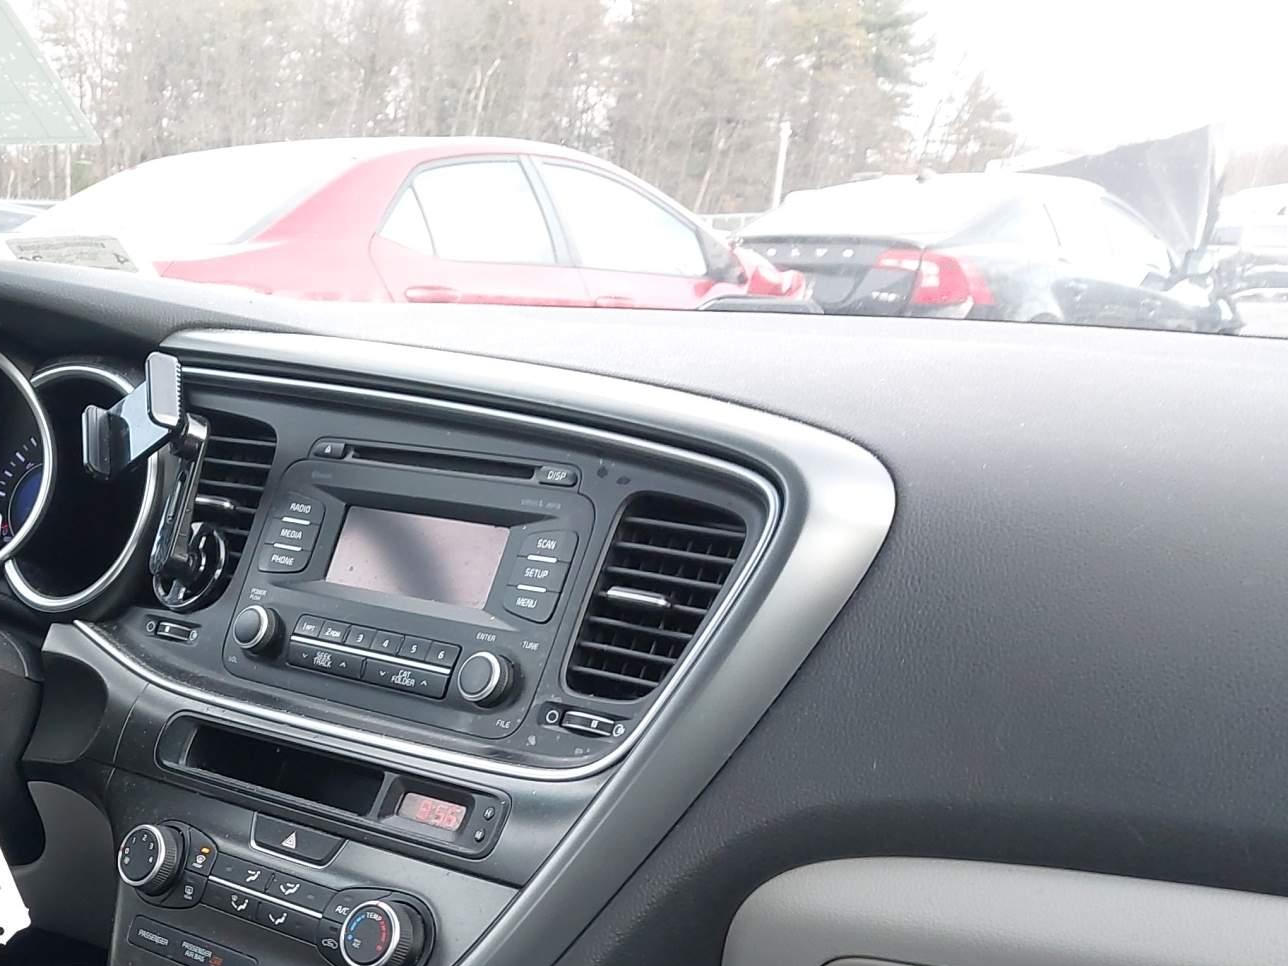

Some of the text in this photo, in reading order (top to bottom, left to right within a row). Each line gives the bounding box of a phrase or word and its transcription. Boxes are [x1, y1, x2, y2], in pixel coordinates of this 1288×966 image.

[547, 470, 567, 481] DISP
[290, 502, 312, 514] RADIO
[280, 528, 302, 539] MEDIA
[537, 538, 557, 550] SCAN
[271, 554, 295, 566] PHONE
[524, 567, 549, 578] SETUP
[516, 597, 537, 609] MENU
[476, 632, 496, 642] ENTER
[383, 639, 390, 648] 4
[437, 650, 445, 659] 6
[391, 675, 415, 687] FOLDER
[495, 719, 512, 729] FILE
[138, 928, 169, 946] PASSENGER
